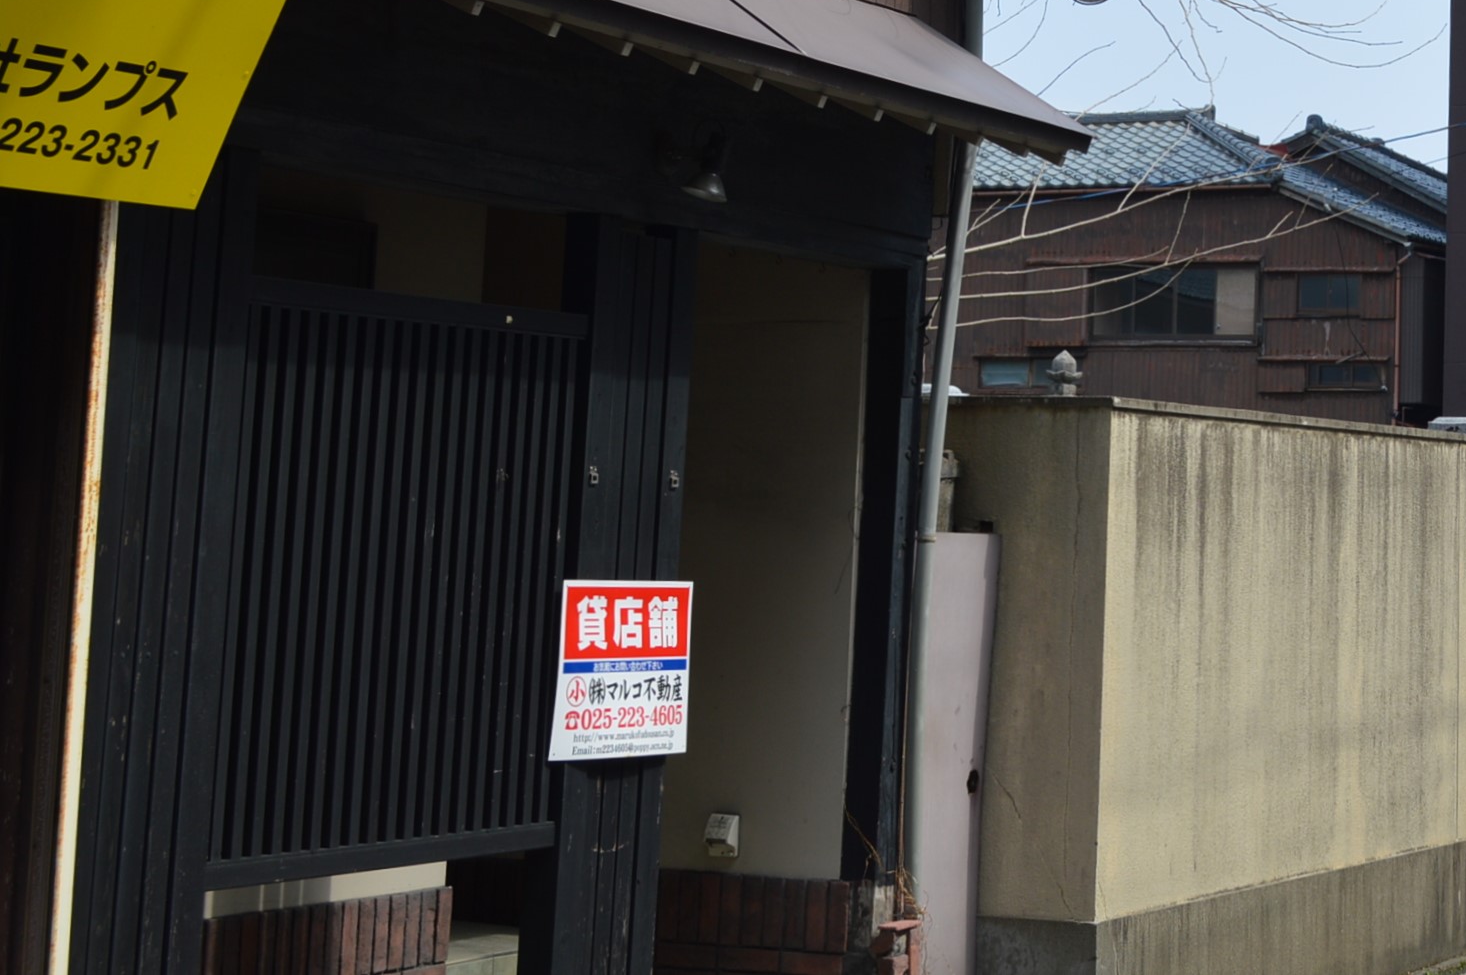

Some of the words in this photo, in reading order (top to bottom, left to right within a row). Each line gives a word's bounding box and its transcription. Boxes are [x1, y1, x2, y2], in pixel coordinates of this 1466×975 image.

[0, 117, 160, 170] 223-2331
[576, 595, 678, 651] 貸店舗
[581, 705, 683, 730] 025-223-4605
